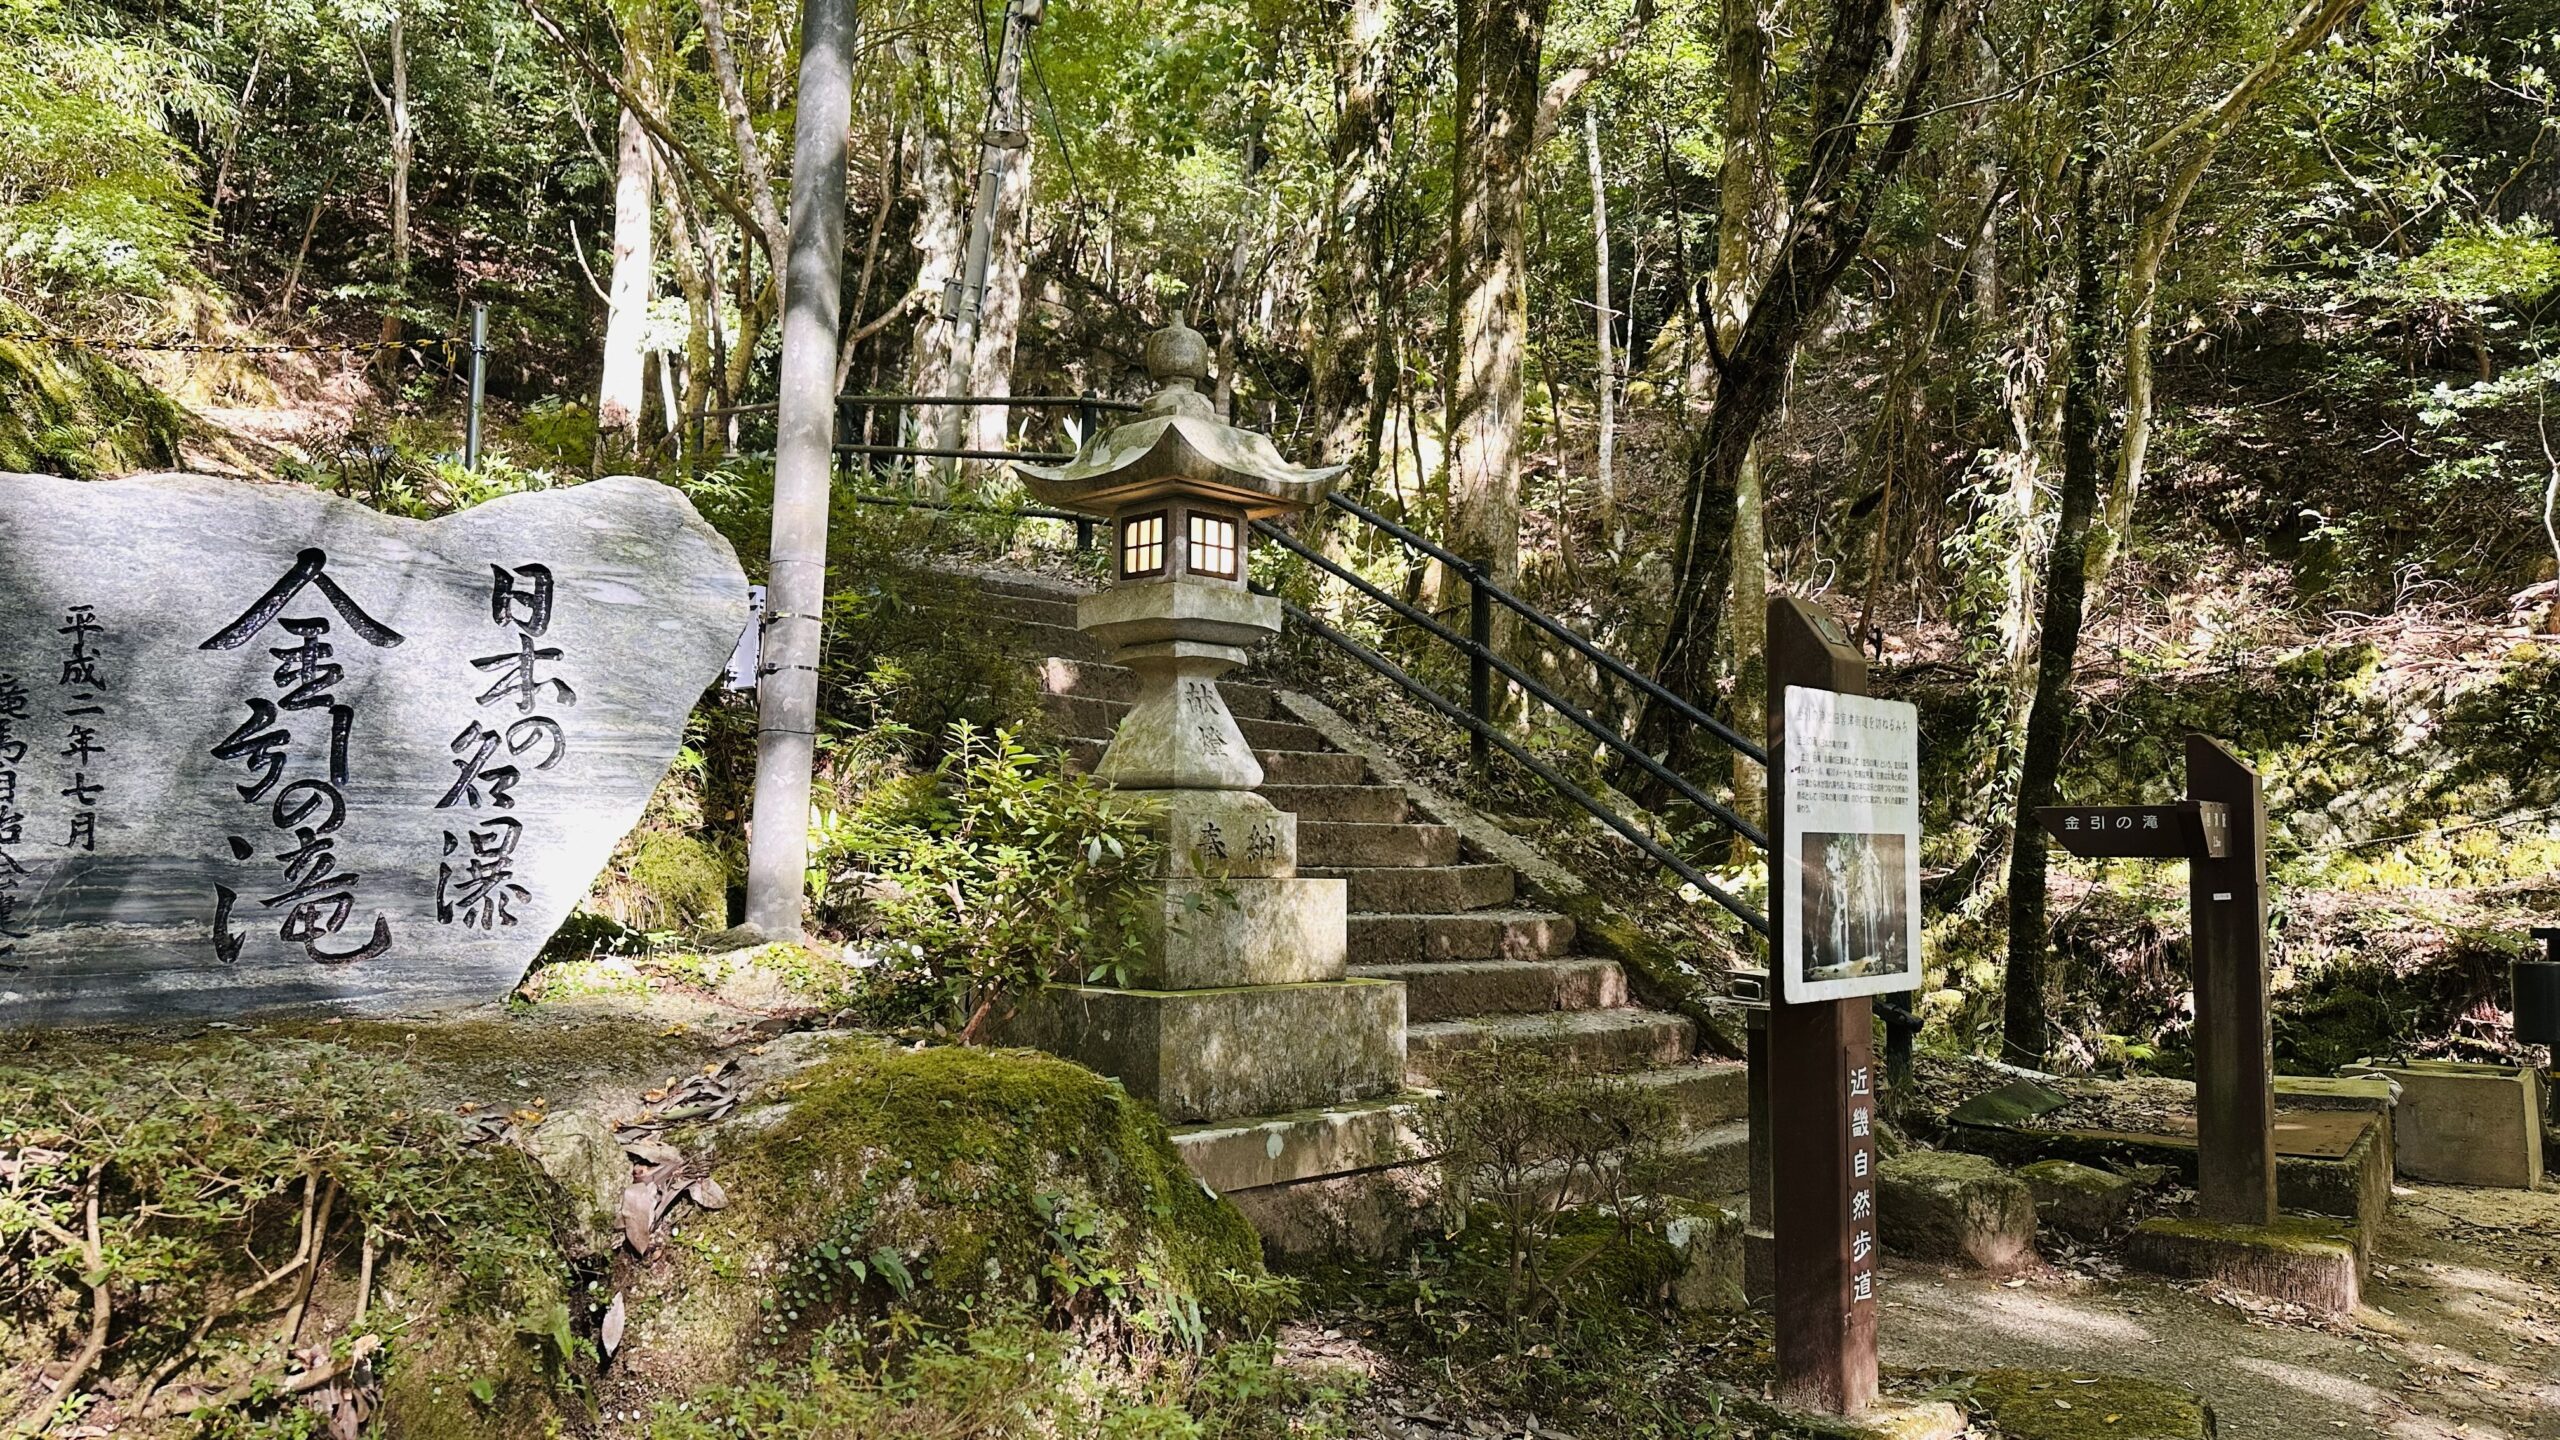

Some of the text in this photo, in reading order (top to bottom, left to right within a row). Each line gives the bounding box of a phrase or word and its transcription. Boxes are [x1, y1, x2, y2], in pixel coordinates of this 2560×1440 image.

[53, 603, 106, 852] 平成二年七月
[199, 547, 406, 964] 金引の滝
[434, 563, 577, 930] 日本の名瀑
[1197, 822, 1276, 866] 奉納
[2064, 815, 2158, 830] 金引の滝
[1850, 1066, 1873, 1303] 近畿自然歩道
